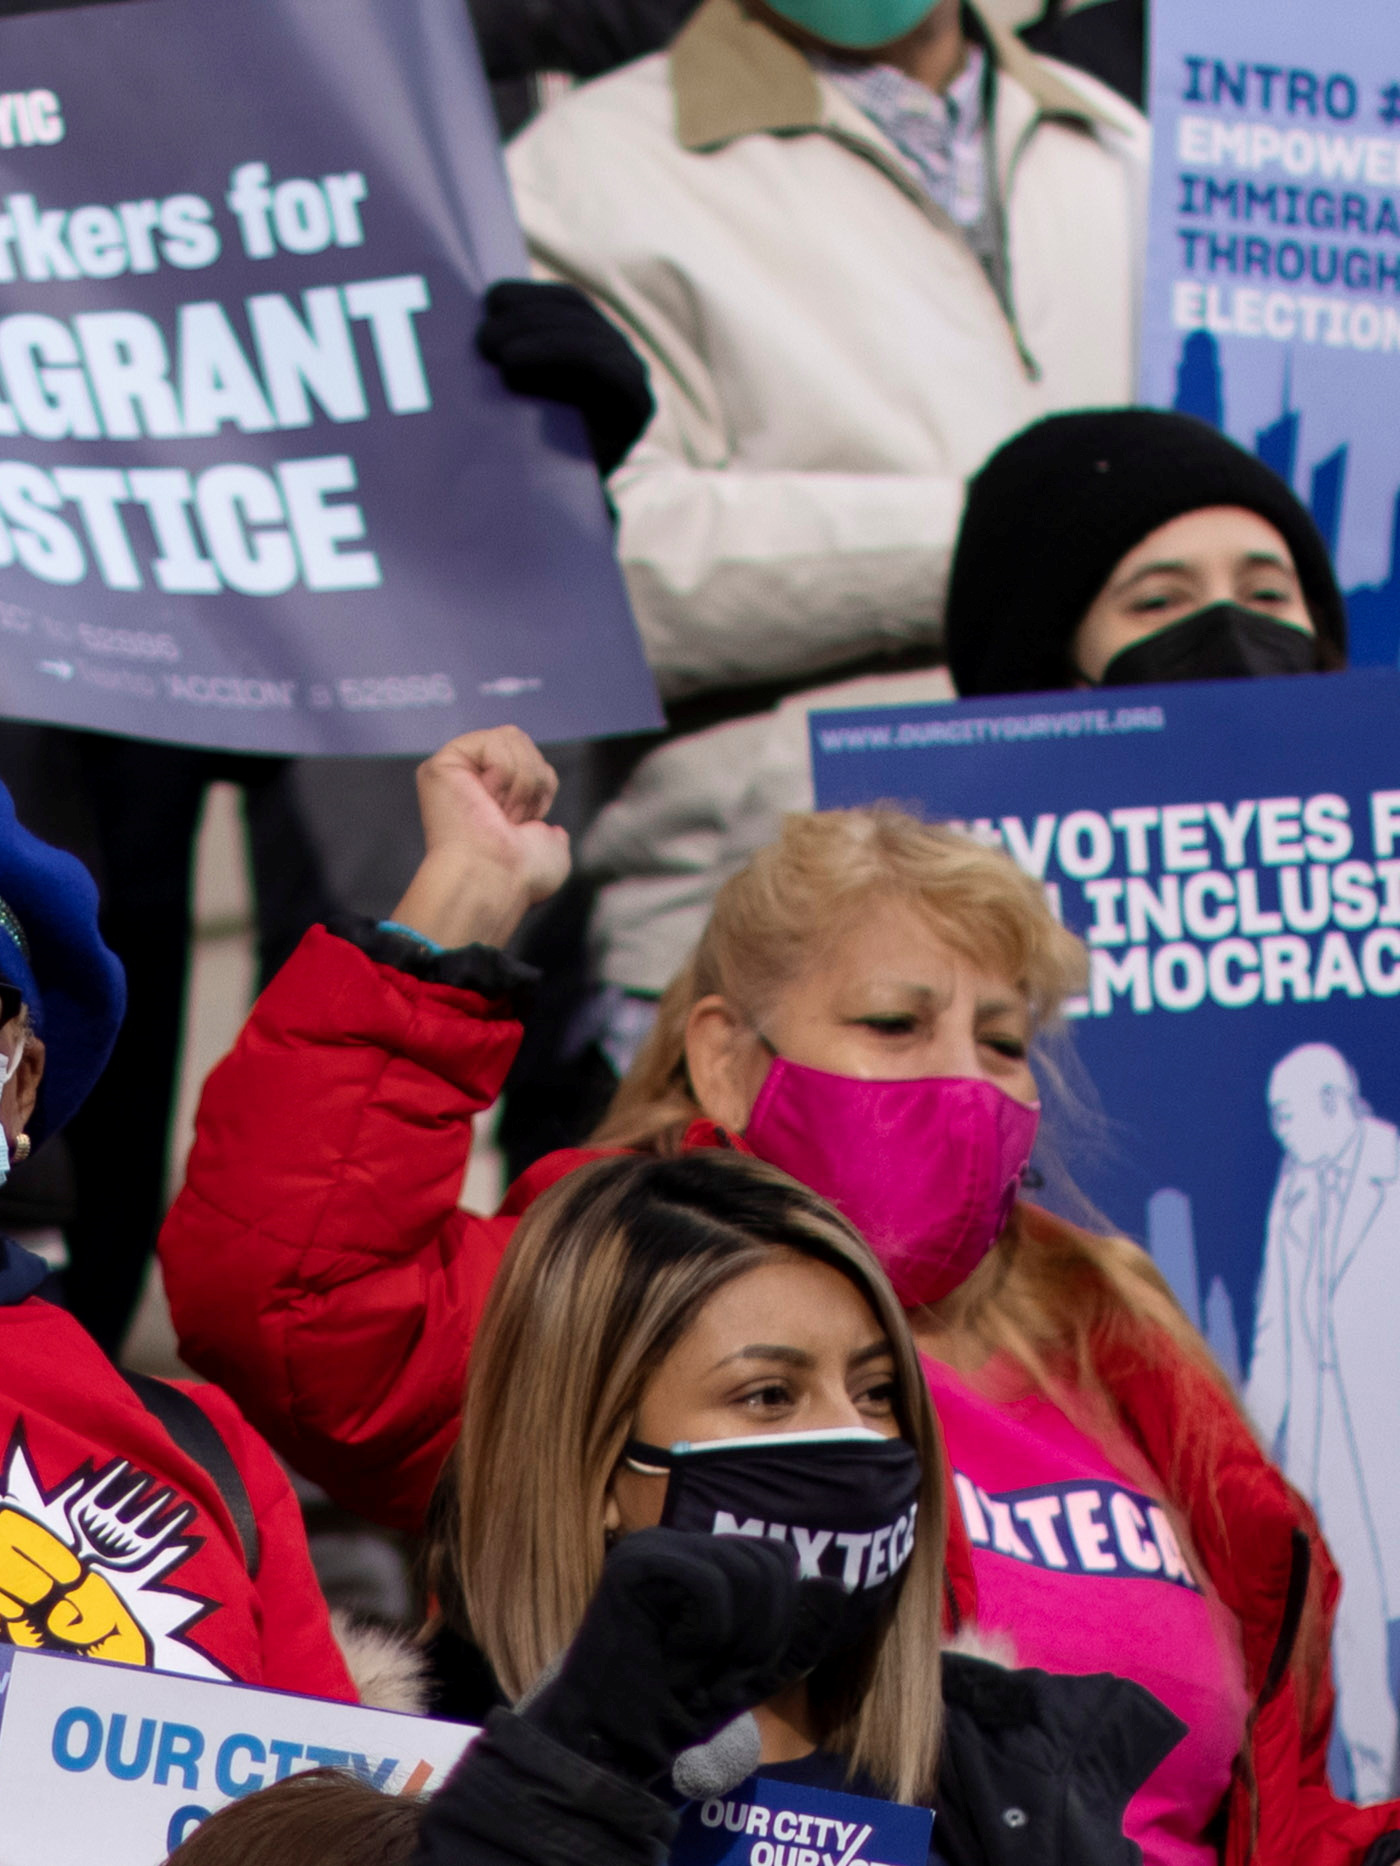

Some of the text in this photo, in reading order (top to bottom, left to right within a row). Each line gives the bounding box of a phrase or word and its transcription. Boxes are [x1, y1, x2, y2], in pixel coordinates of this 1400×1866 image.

[1183, 56, 1358, 121] INTRO
[1177, 116, 1400, 186] EMPOWE
[227, 161, 369, 260] for
[819, 707, 1165, 751] WWW.OURCITYOURVOTE.ORG
[1062, 928, 1400, 1018] MOCRAC
[954, 1472, 1196, 1587] IXTECA
[51, 1706, 205, 1791] OUR
[701, 1800, 771, 1838] OUR
